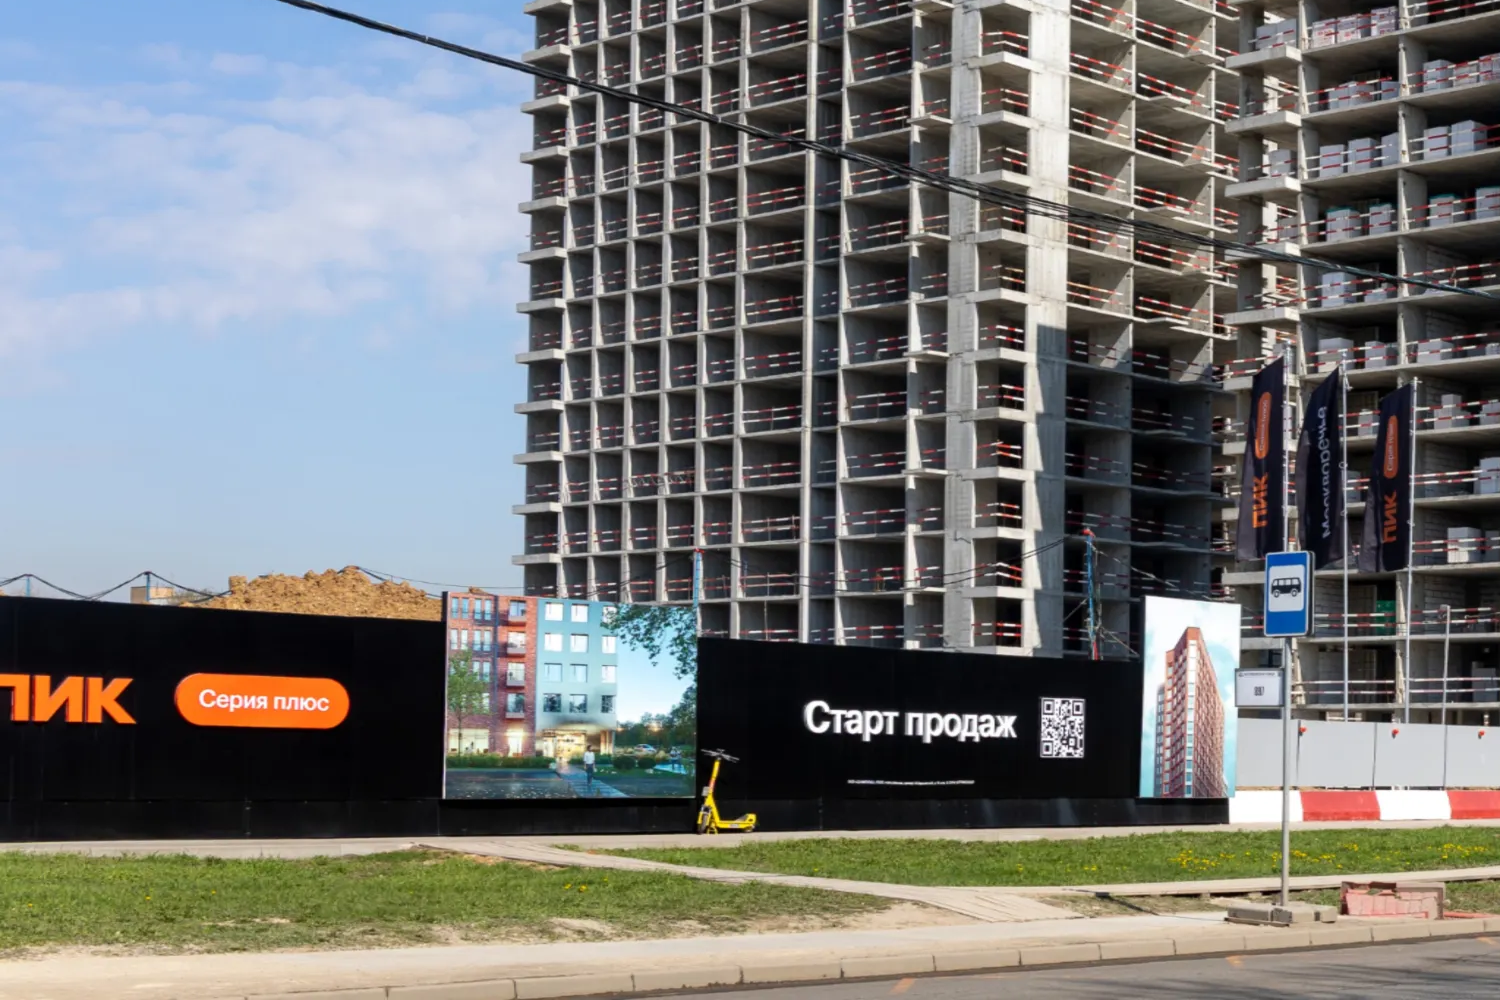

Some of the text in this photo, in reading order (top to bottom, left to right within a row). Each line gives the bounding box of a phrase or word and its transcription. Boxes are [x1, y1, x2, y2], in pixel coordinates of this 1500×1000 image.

[1252, 472, 1268, 528] ПИК
[1382, 490, 1397, 543] ПИК
[199, 689, 266, 712] Серия
[274, 697, 328, 711] плюс
[804, 700, 1017, 743] Старт продаж
